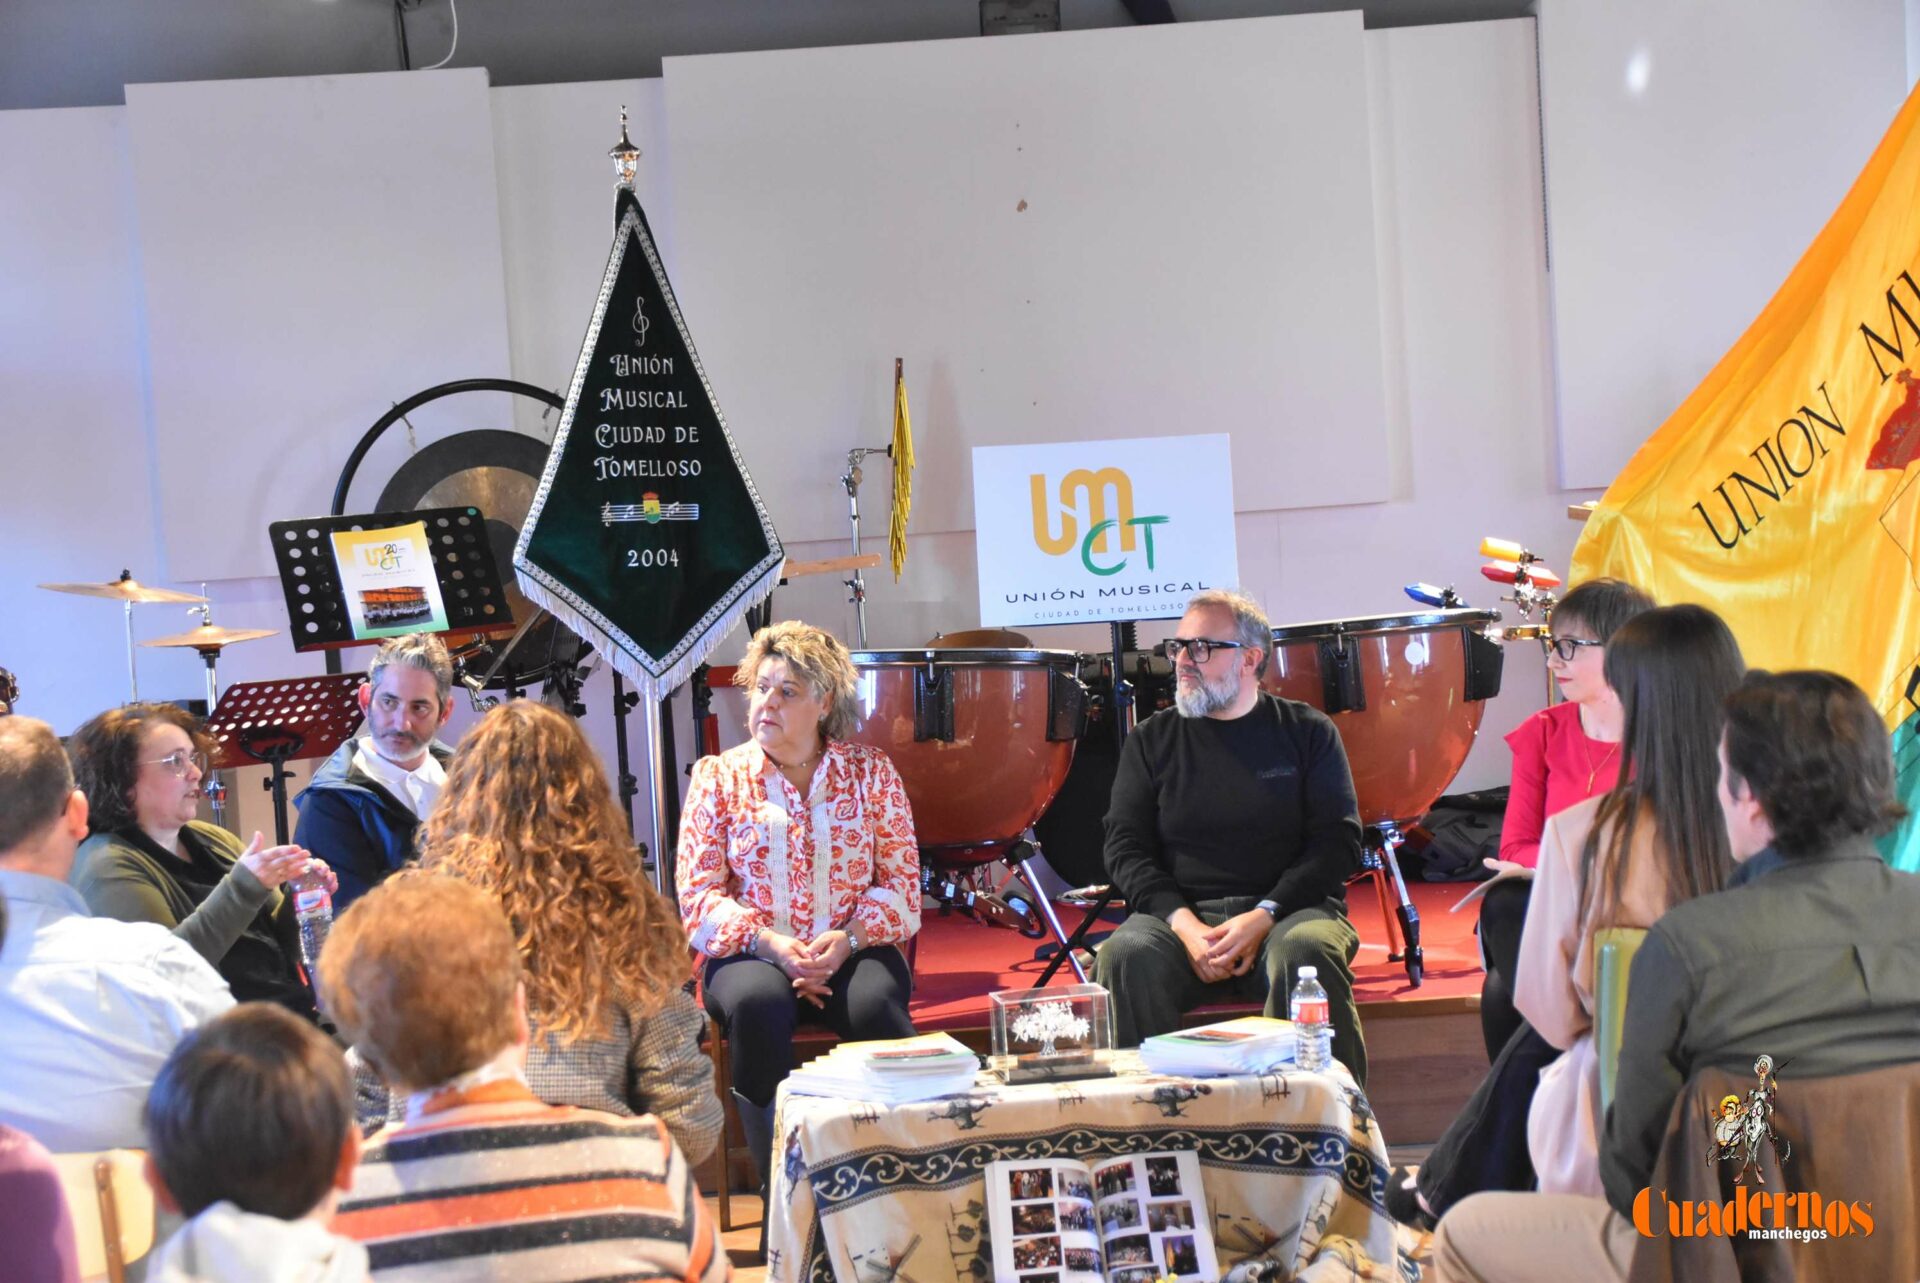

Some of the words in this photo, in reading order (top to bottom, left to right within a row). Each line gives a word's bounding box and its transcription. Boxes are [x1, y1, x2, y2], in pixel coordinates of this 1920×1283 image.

[609, 353, 674, 377] UNIÓN
[600, 387, 688, 412] MUSICAL
[595, 423, 666, 448] CIUDAD
[675, 426, 699, 444] DE
[593, 456, 702, 482] TOMELLOSO
[1692, 381, 1847, 550] UNION
[627, 549, 680, 568] 2004
[1005, 588, 1085, 604] UNIÓN
[1098, 581, 1211, 597] MUSICAL
[1034, 609, 1080, 619] CIUDAD
[1110, 602, 1184, 614] TOMELLOSO
